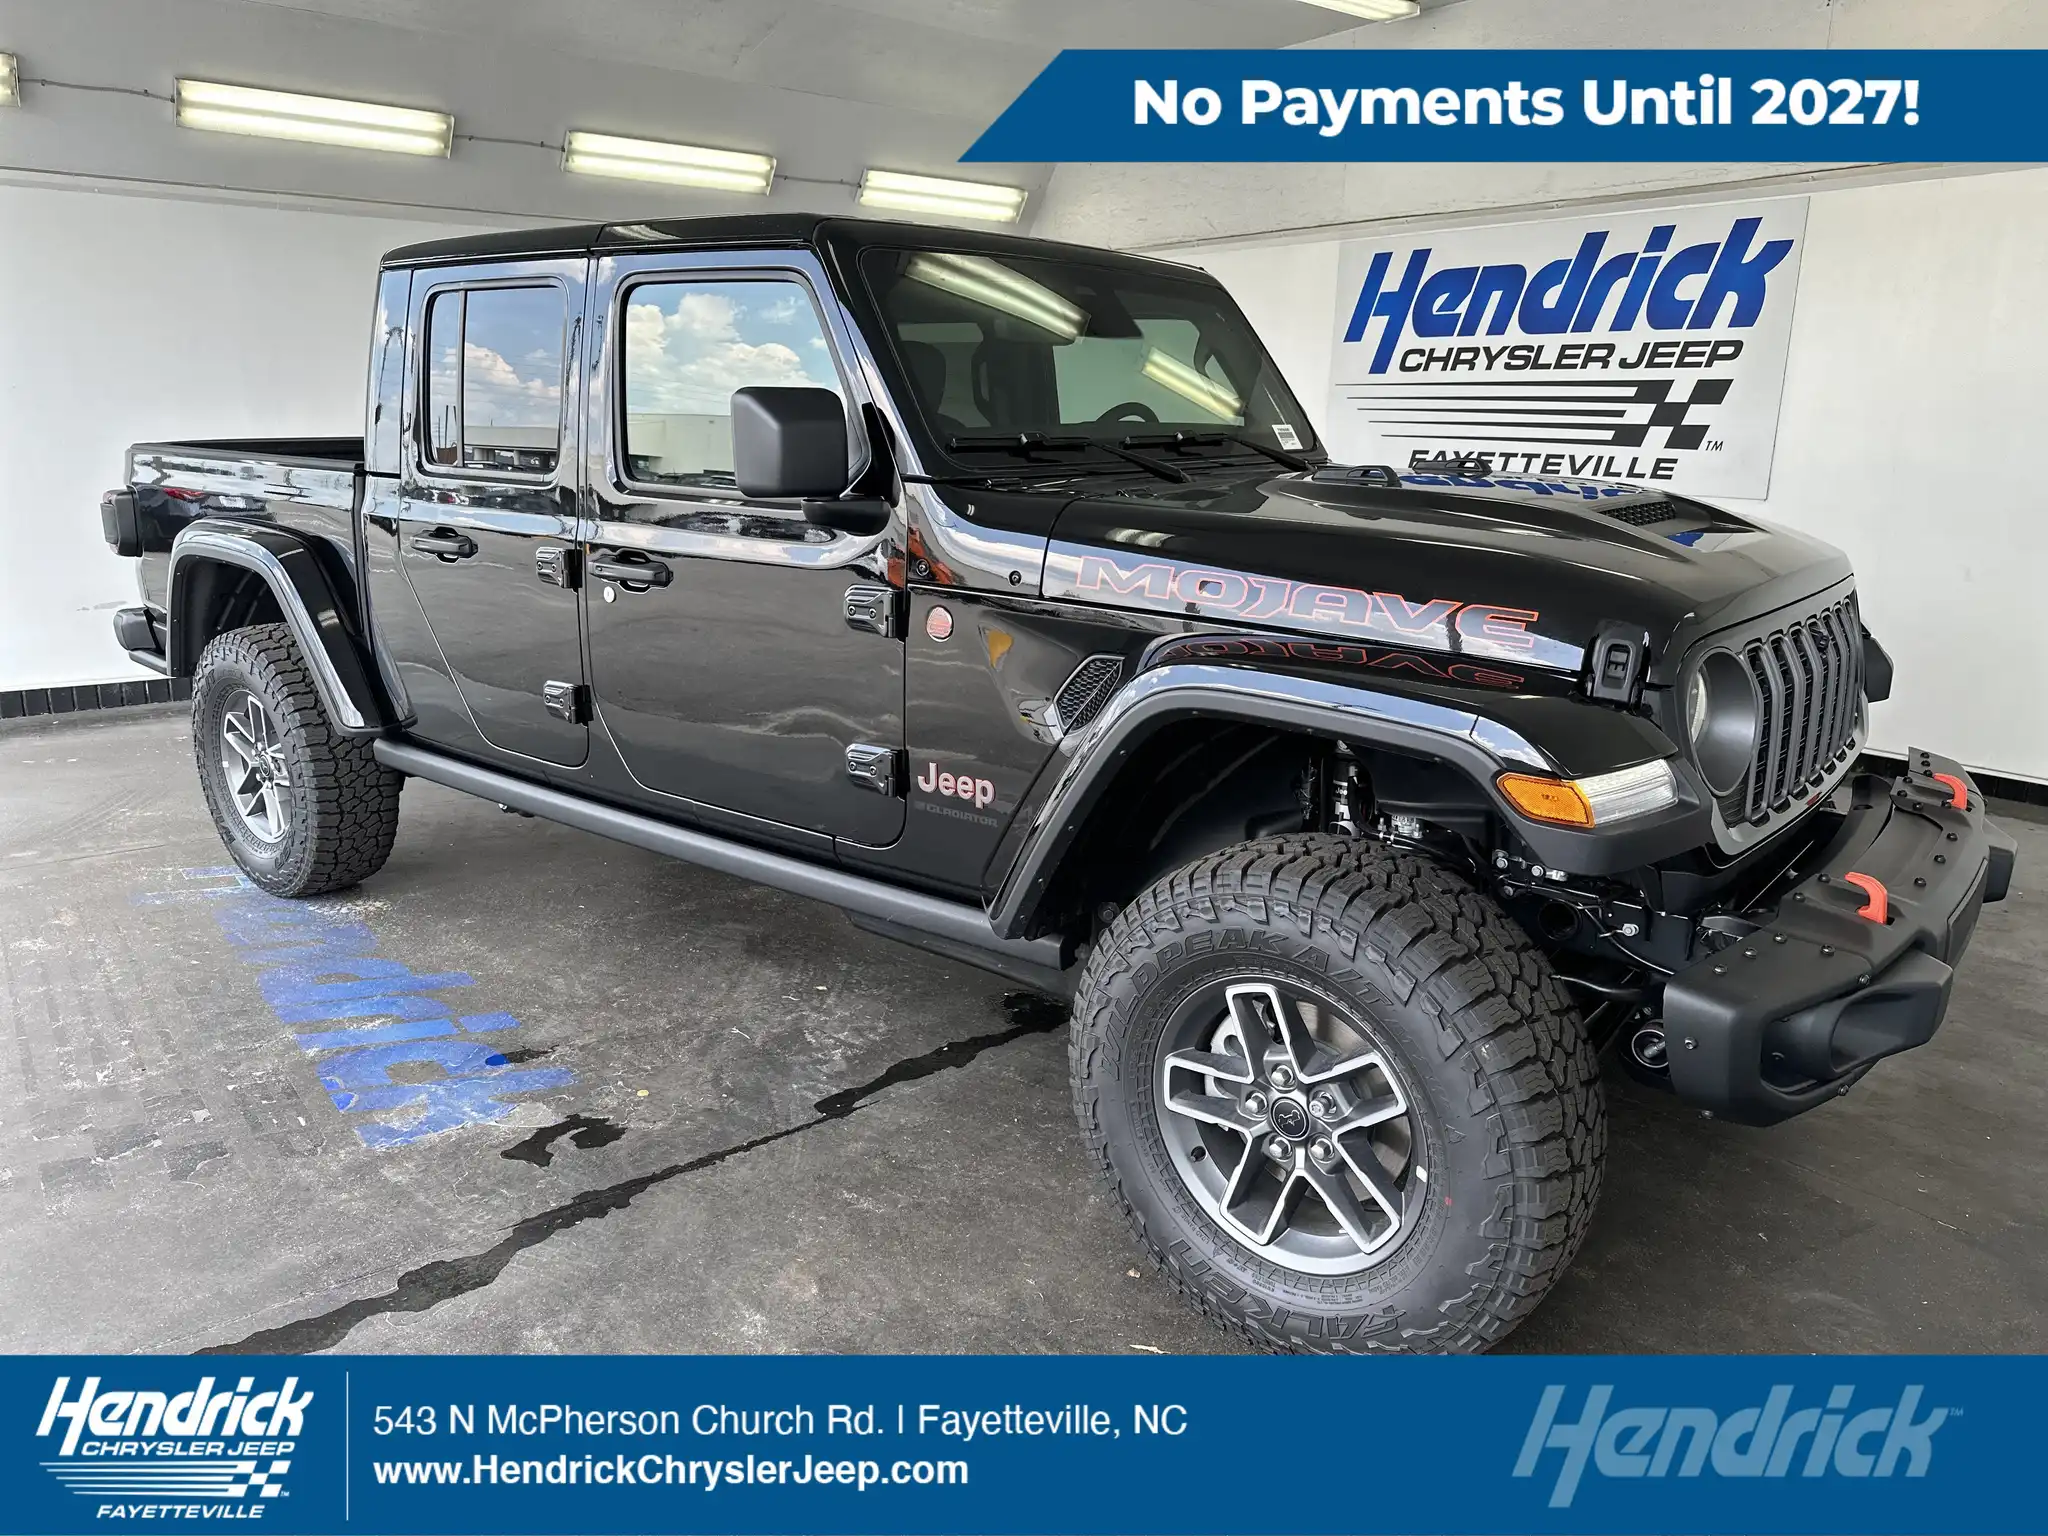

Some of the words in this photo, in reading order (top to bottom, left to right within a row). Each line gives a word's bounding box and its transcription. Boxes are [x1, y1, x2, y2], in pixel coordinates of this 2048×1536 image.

[1343, 217, 1793, 374] Hendrick
[1399, 342, 1616, 373] CHRYSLER
[1618, 340, 1744, 369] JEEP
[1076, 555, 1539, 648] MOJAVE
[917, 762, 995, 809] Jeep
[926, 803, 998, 828] GLADIATOR
[1099, 926, 1289, 1081] WILDPEAK
